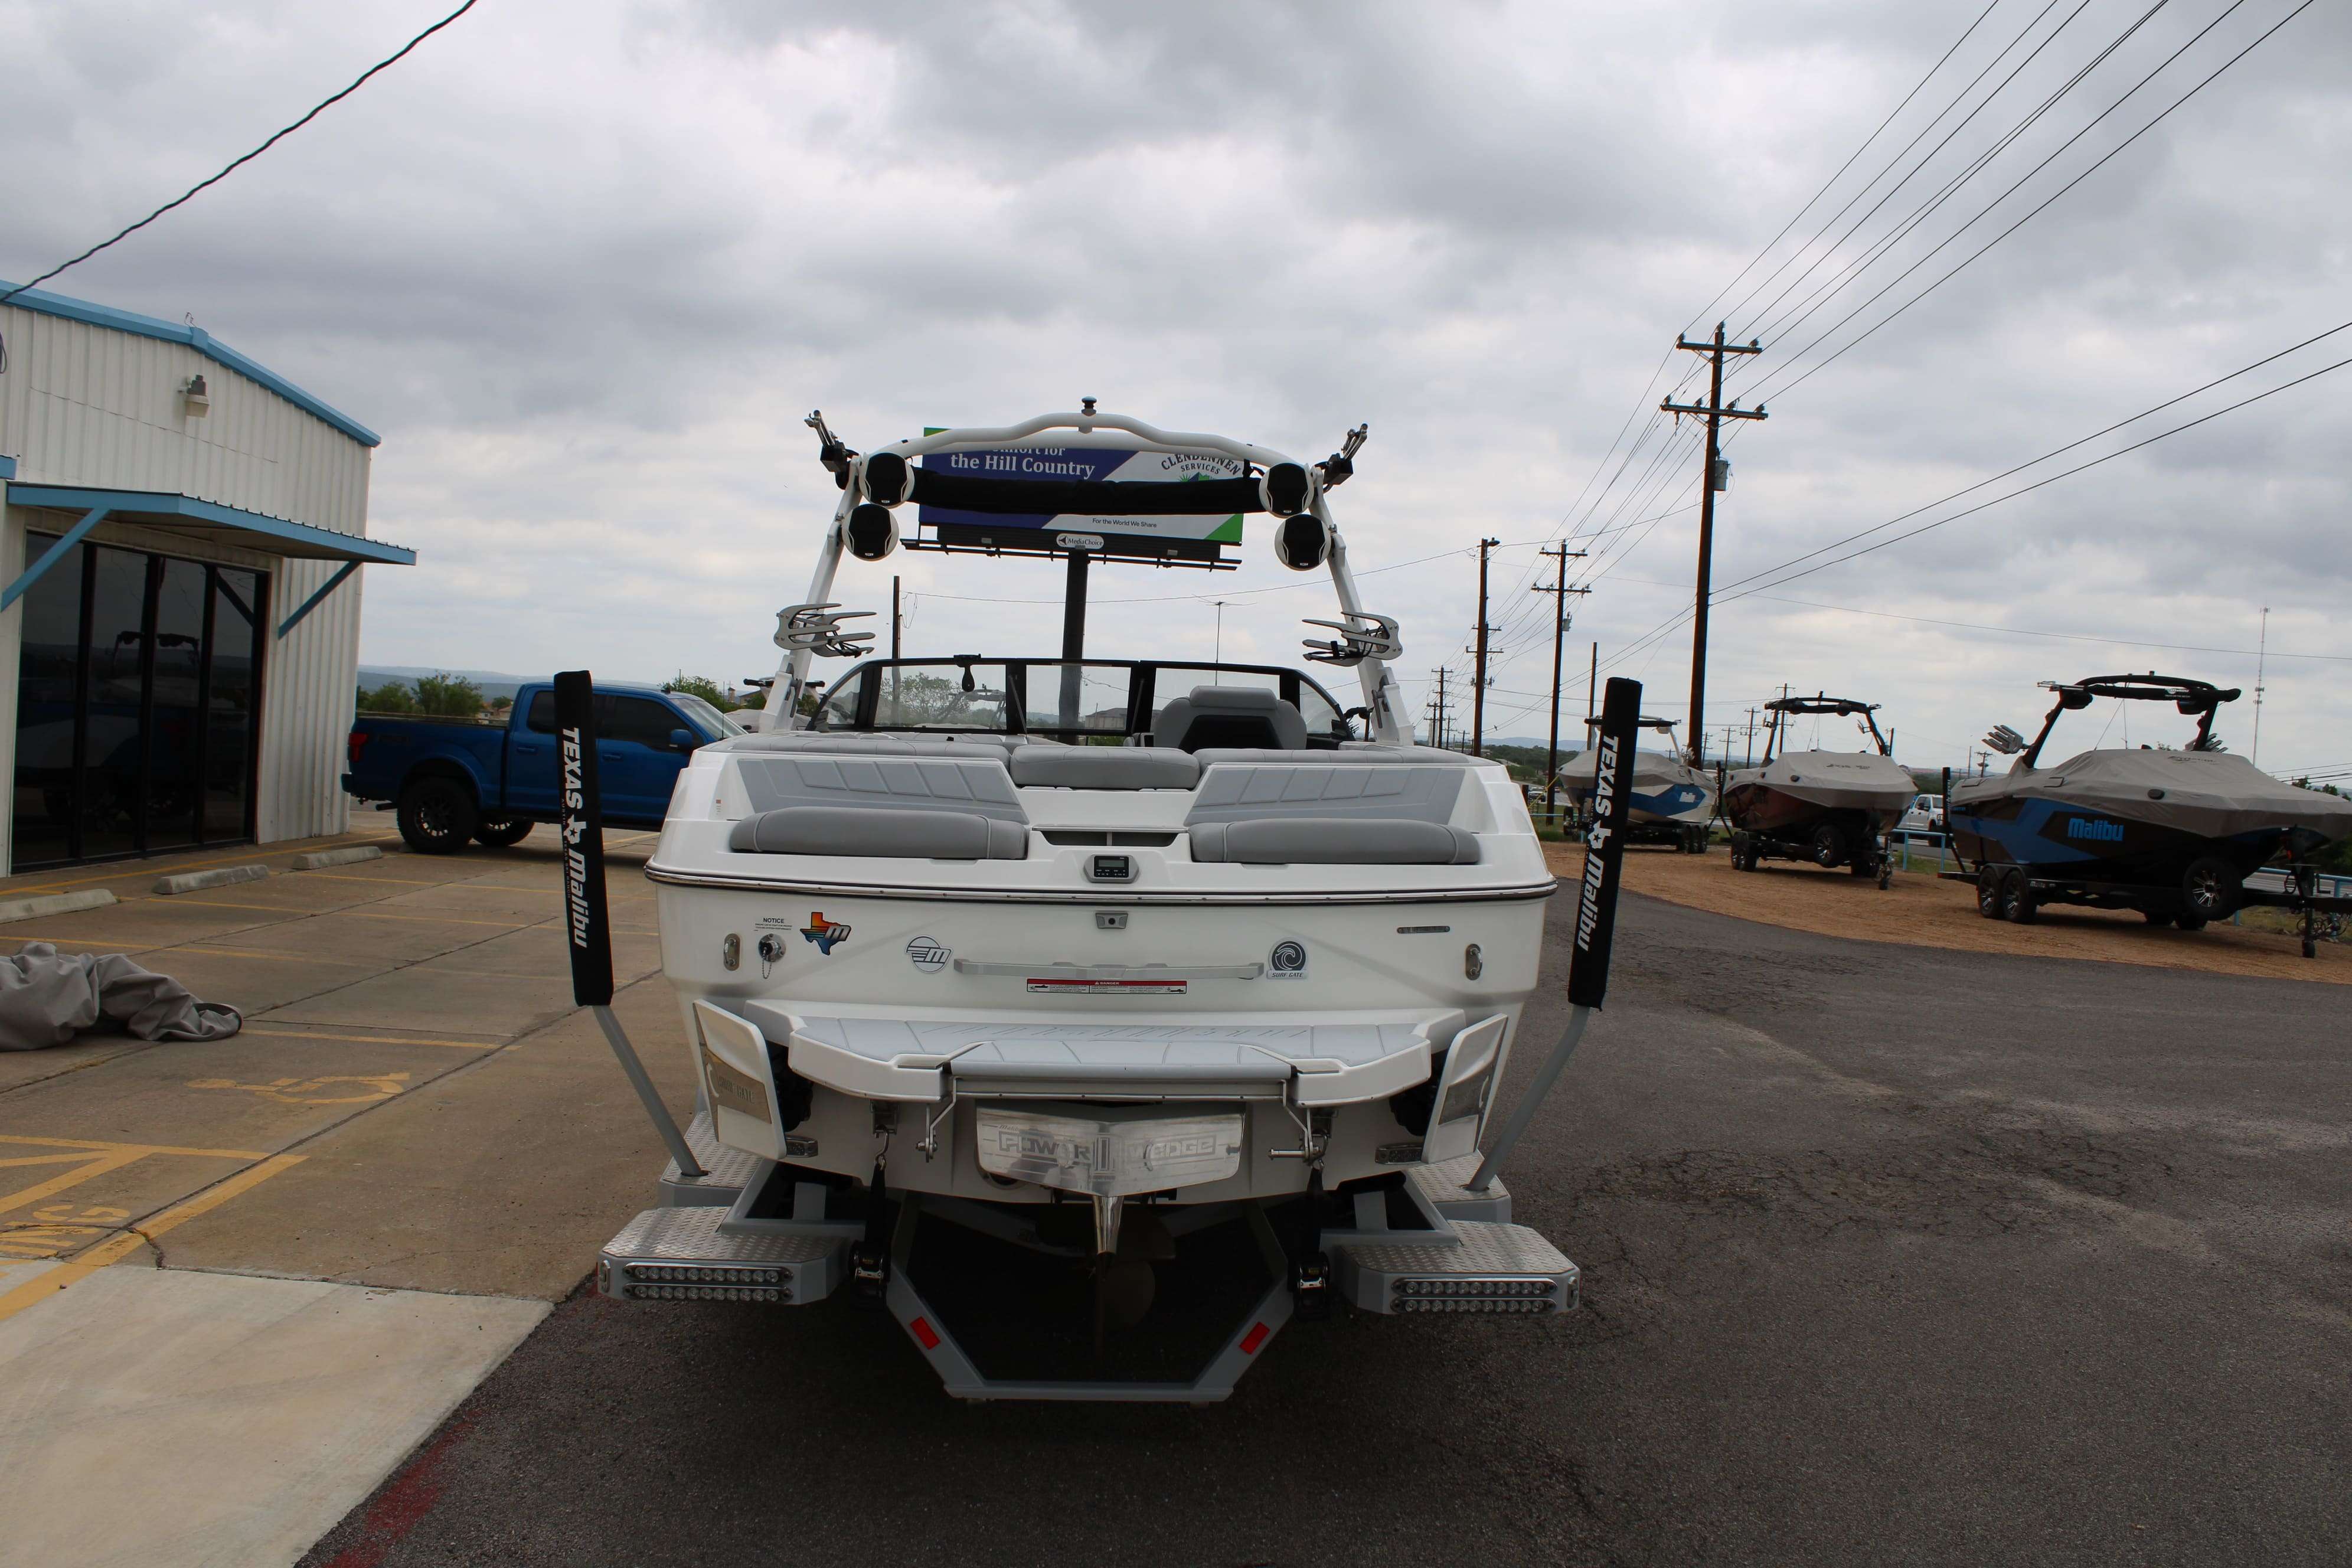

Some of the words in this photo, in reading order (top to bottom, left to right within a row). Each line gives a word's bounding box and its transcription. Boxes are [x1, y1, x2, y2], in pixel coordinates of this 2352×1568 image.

[951, 453, 979, 469] the
[985, 455, 1017, 471] Hill
[1022, 458, 1095, 479] Country
[1181, 463, 1220, 475] SERVICES
[1069, 538, 1103, 546] MediaChoice
[562, 727, 583, 810] TEXAS
[1595, 735, 1618, 817] TEXAS
